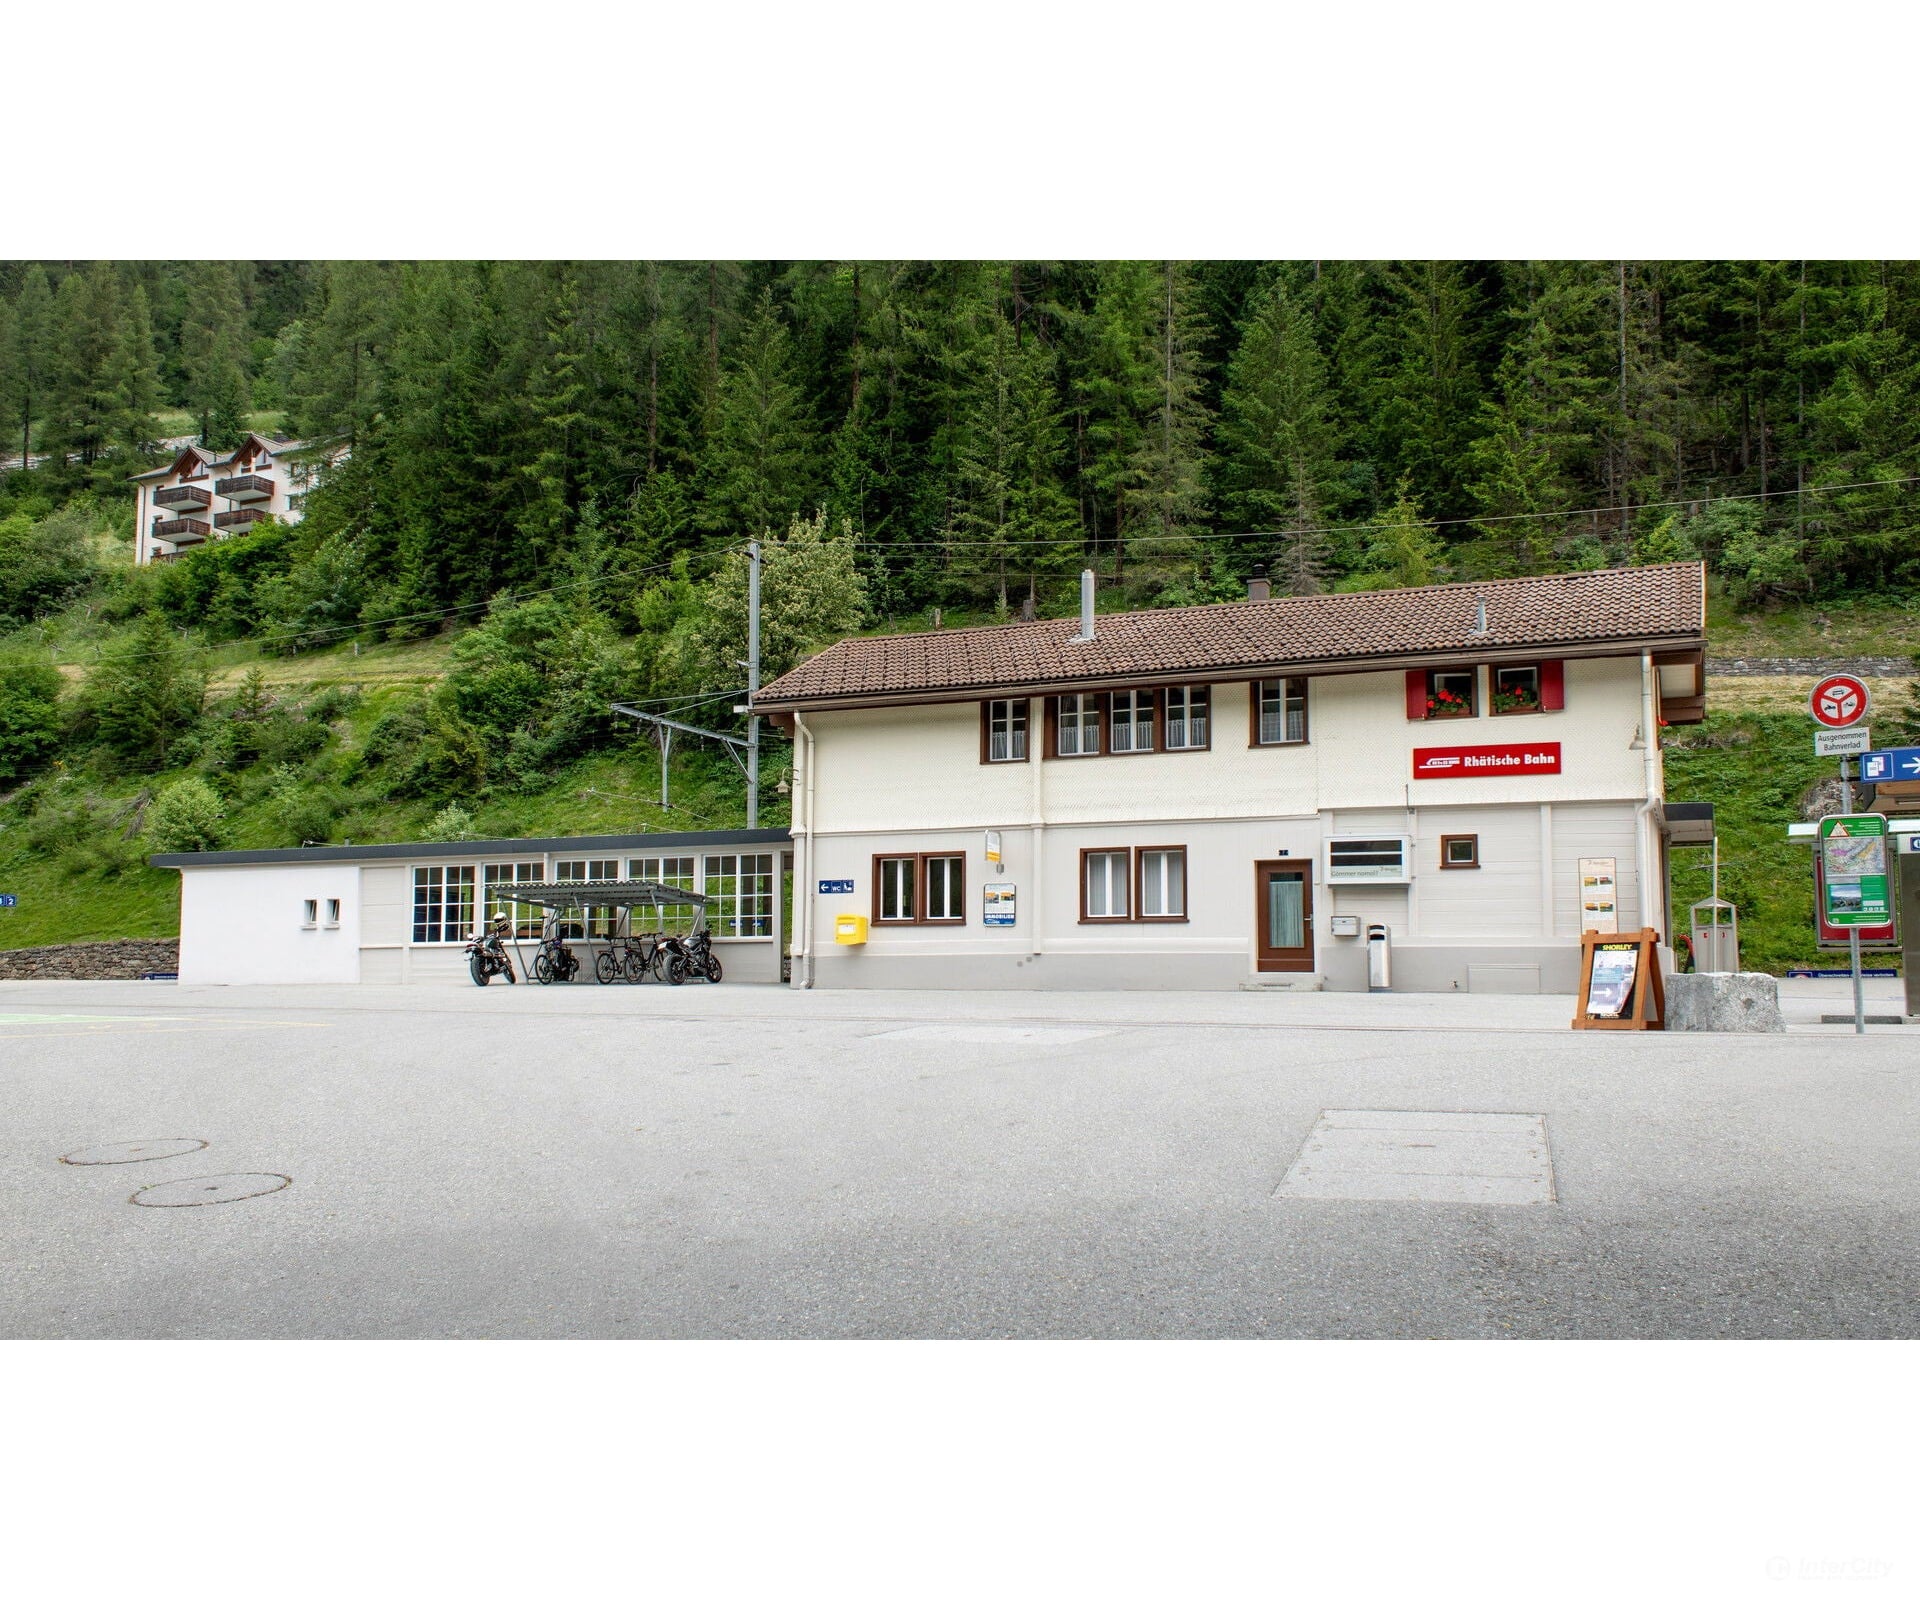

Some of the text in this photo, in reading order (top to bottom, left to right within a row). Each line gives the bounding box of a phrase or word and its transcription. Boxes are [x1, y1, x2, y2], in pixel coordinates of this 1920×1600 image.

[1817, 731, 1867, 743] Ausgenommen
[1824, 741, 1861, 751] Bahnverlad
[1464, 754, 1521, 767] Rhätische
[1524, 752, 1555, 765] Bahn
